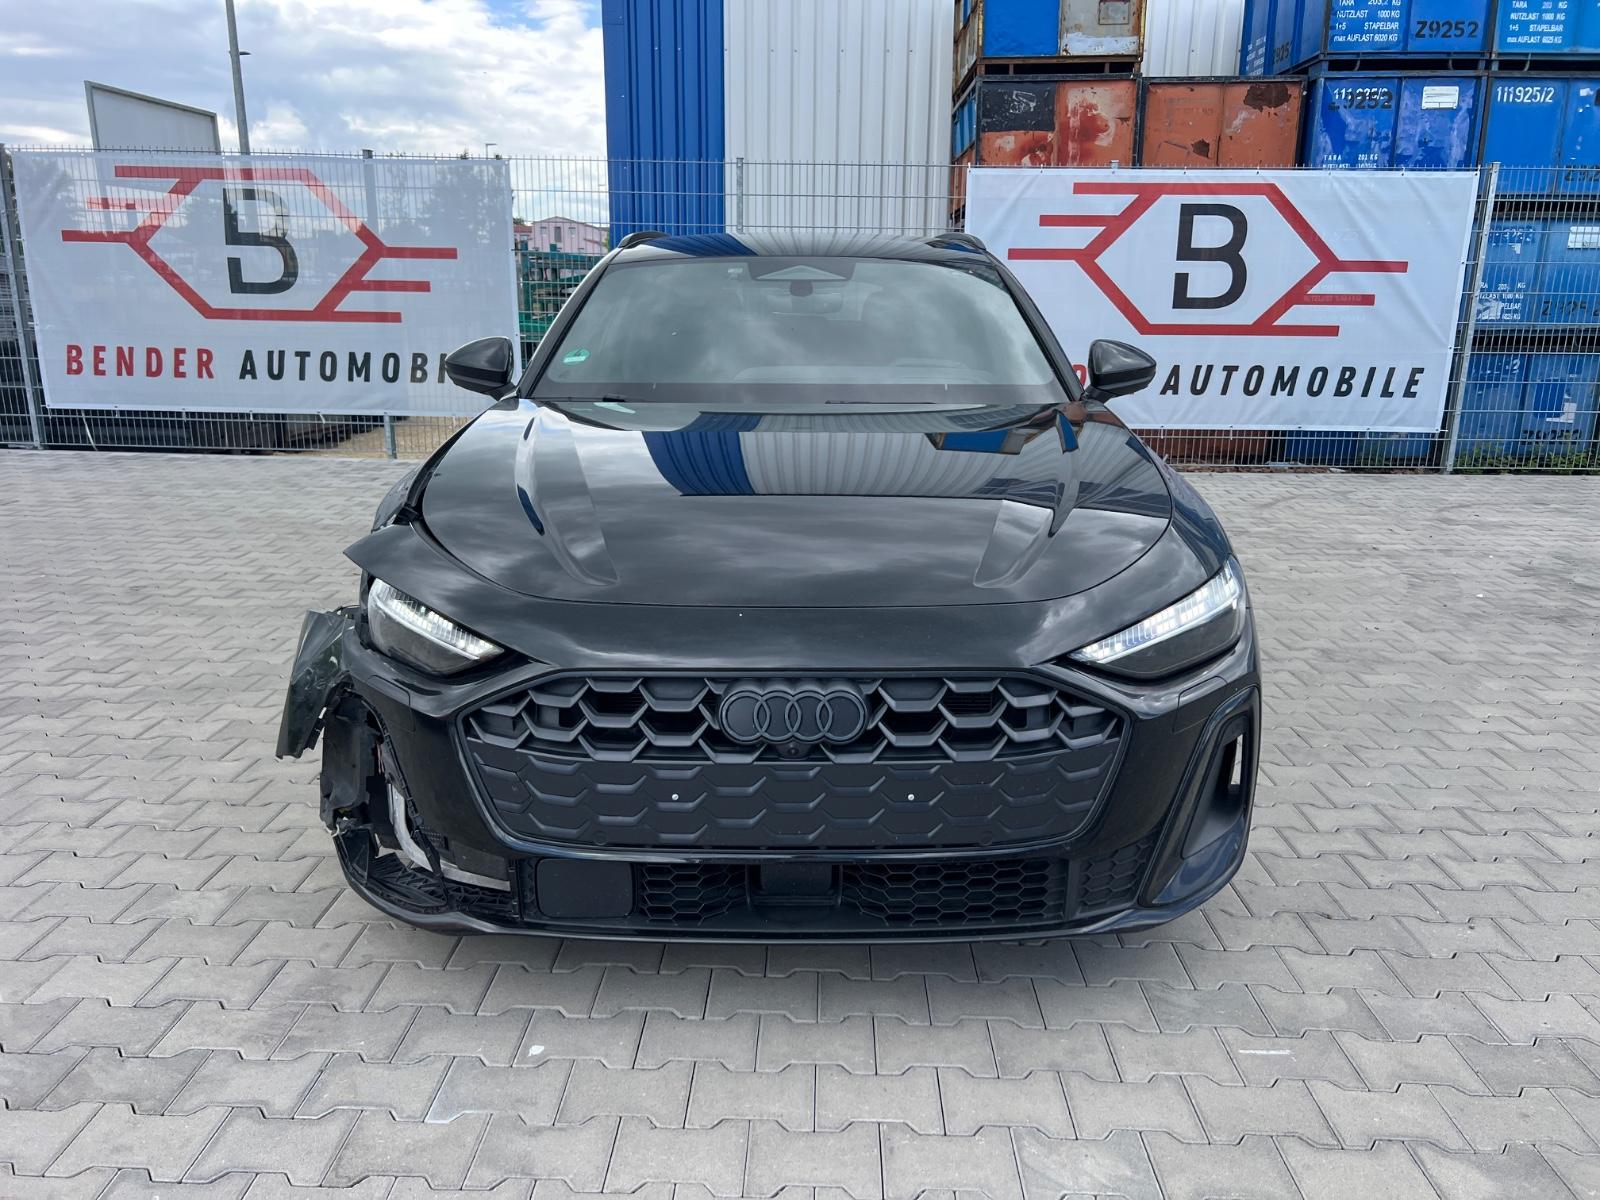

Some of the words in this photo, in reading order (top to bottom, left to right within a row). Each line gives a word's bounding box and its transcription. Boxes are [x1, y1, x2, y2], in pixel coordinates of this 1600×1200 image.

[1336, 10, 1369, 18] NUTZLAST
[1377, 10, 1390, 18] 1000
[1391, 10, 1400, 18] KG
[1336, 22, 1347, 30] 1+5
[1364, 22, 1399, 30] STAPELBAR
[1415, 20, 1479, 39] Z9252
[1529, 24, 1564, 32] STAPELBAR
[1346, 33, 1374, 42] AUFLAST
[1497, 86, 1554, 103] 111925/2
[223, 188, 299, 295] B
[1172, 203, 1248, 310] B
[66, 344, 215, 380] BENDER
[239, 349, 447, 384] AUTOMOBI
[1159, 364, 1425, 399] AUTOMOBILE
